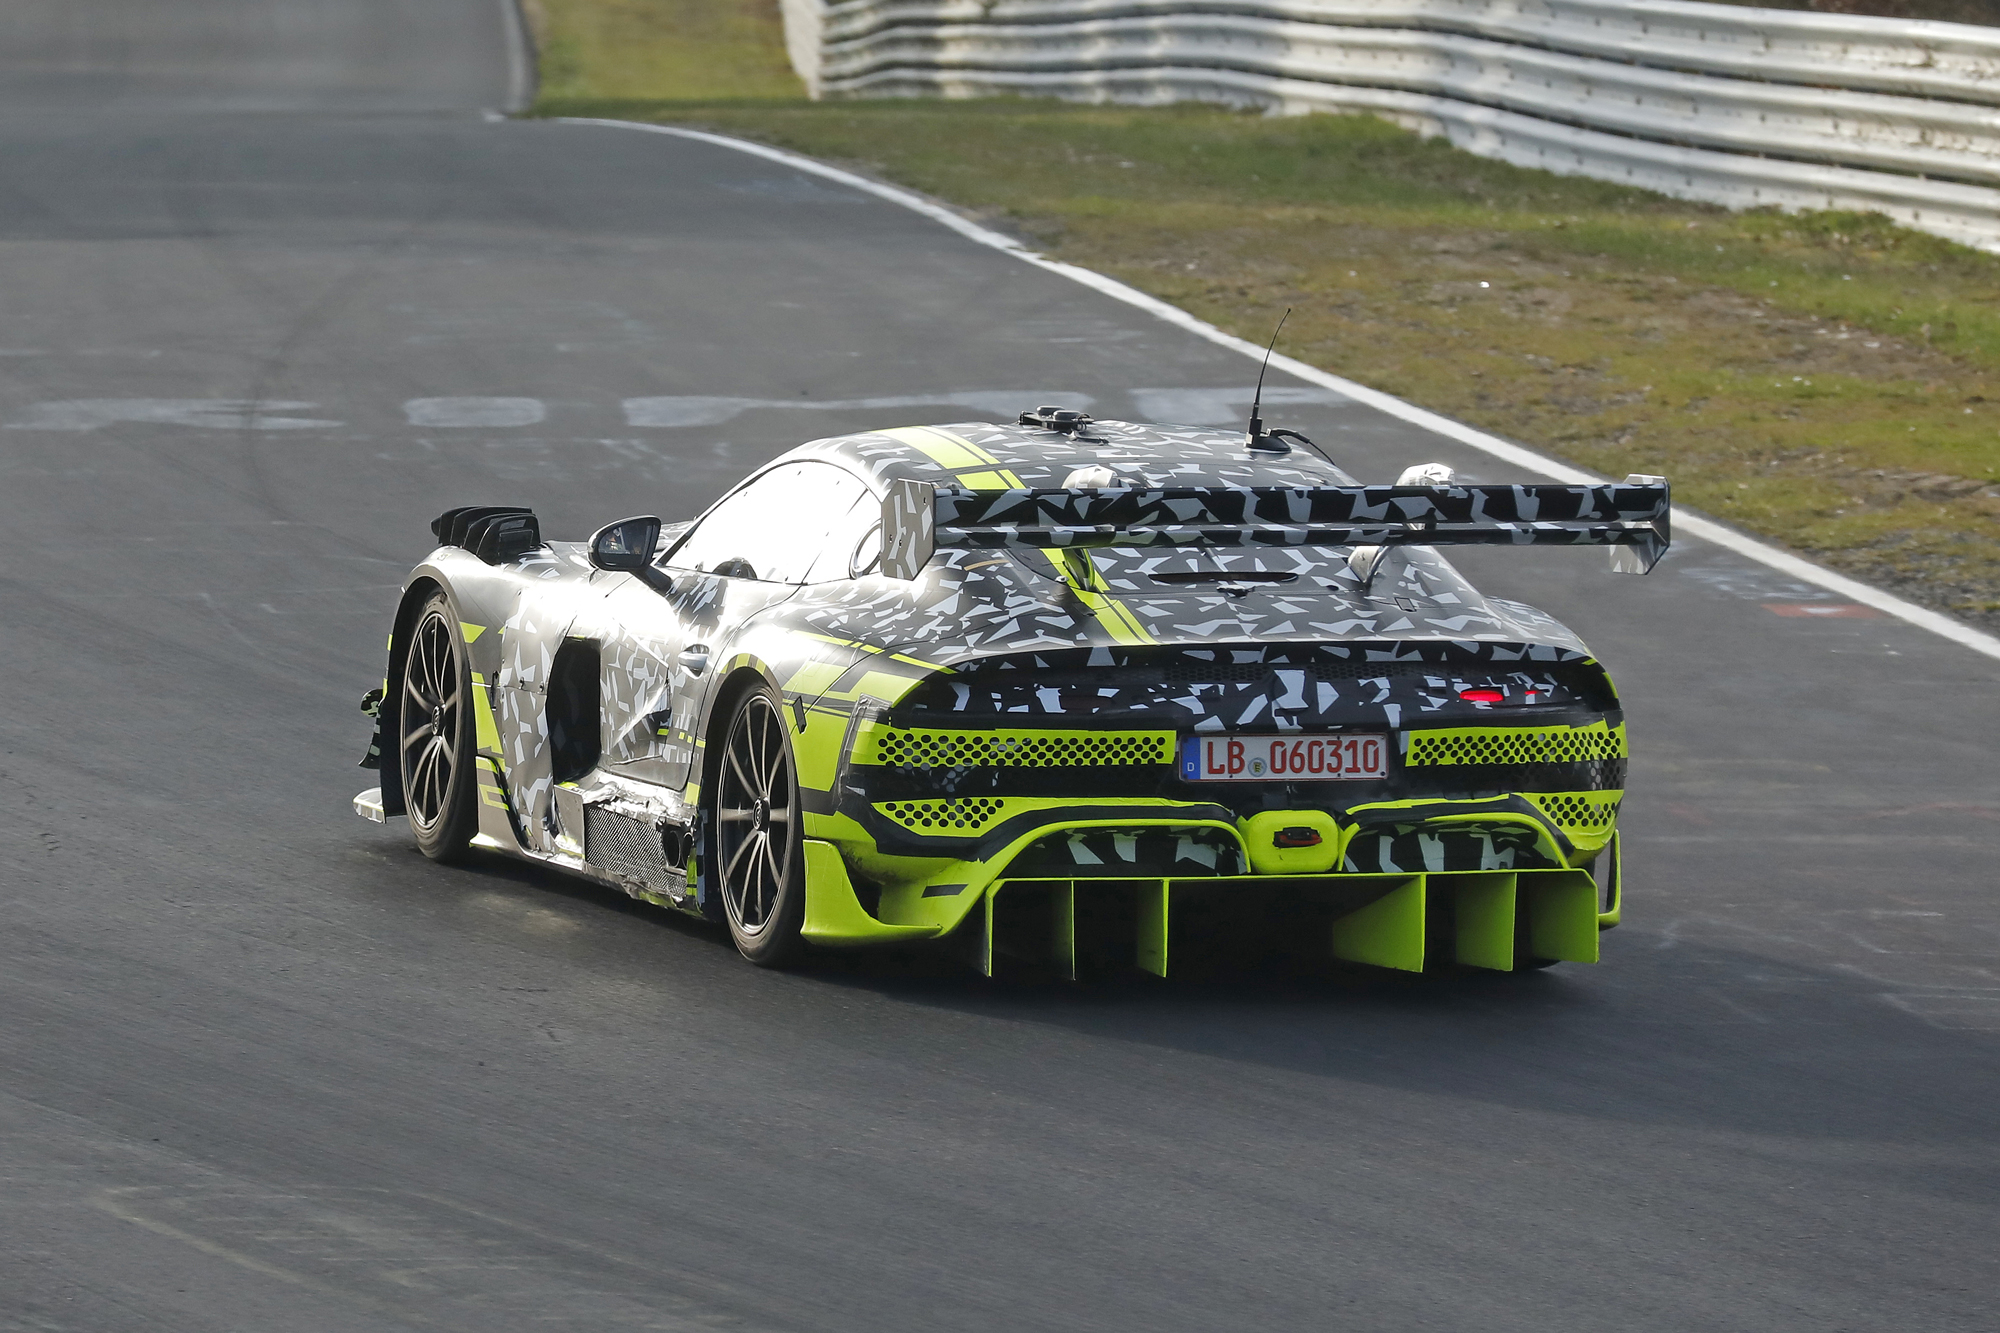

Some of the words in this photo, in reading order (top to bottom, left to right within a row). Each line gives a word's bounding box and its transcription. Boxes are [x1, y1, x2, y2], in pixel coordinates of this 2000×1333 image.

[1187, 762, 1195, 772] D
[1207, 741, 1245, 774] LB
[1269, 740, 1380, 774] 060310
